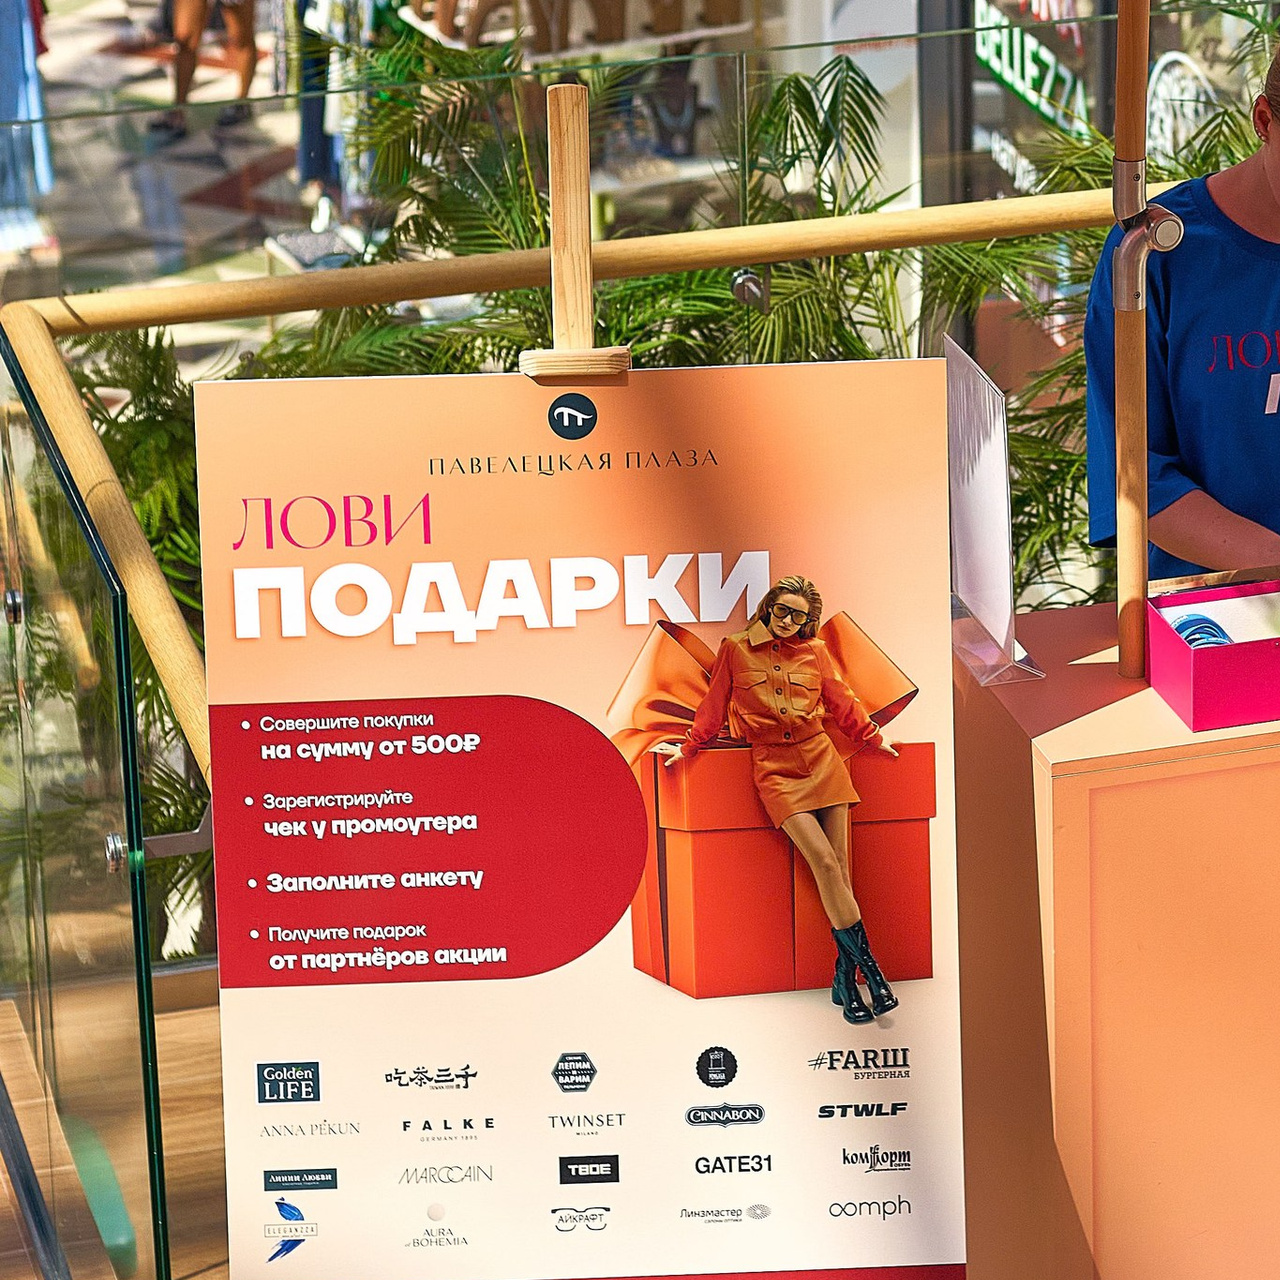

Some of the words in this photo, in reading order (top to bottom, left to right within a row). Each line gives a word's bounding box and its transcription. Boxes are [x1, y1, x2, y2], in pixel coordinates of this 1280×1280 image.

[429, 454, 612, 476] ПАВЕЛЕЦКАЯ
[625, 449, 718, 469] ПЛАЗА
[232, 493, 432, 550] ЛОВИ
[232, 550, 771, 645] ПОДАРКИ
[259, 715, 360, 733] Совершите
[363, 713, 434, 730] покупки
[261, 743, 292, 760] на
[296, 740, 374, 762] сумму
[379, 739, 407, 756] от
[411, 733, 481, 754] 500₽
[262, 789, 414, 811] Зарегистрируйте
[263, 821, 307, 837] чек
[311, 819, 327, 839] у
[331, 813, 478, 838] промоутера
[266, 872, 396, 893] Заполните
[400, 870, 484, 889] анкету
[268, 926, 349, 944] Получите
[352, 923, 427, 940] подарок
[269, 954, 297, 970] от
[301, 946, 429, 972] партнёров
[433, 946, 507, 966] акции
[263, 1067, 314, 1080] Golden
[384, 1063, 478, 1089] 吃茶三千
[558, 1075, 591, 1084] ВАРИМ
[854, 1070, 910, 1080] БУРГЕРНАЯ
[264, 1081, 314, 1100] LIFE
[818, 1102, 908, 1119] STWLF
[402, 1117, 495, 1132] FALKE
[548, 1113, 626, 1129] TWINSET
[260, 1125, 306, 1137] ANNA
[567, 1163, 612, 1176] ТВОЕ
[695, 1154, 772, 1175] GATE31
[558, 1213, 604, 1223] АЙКРАФТ
[680, 1208, 742, 1219] Линзмастер
[267, 1226, 315, 1235] ELEGANZZA
[423, 1227, 454, 1237] AURA
[412, 1237, 468, 1247] BOHEMIA
